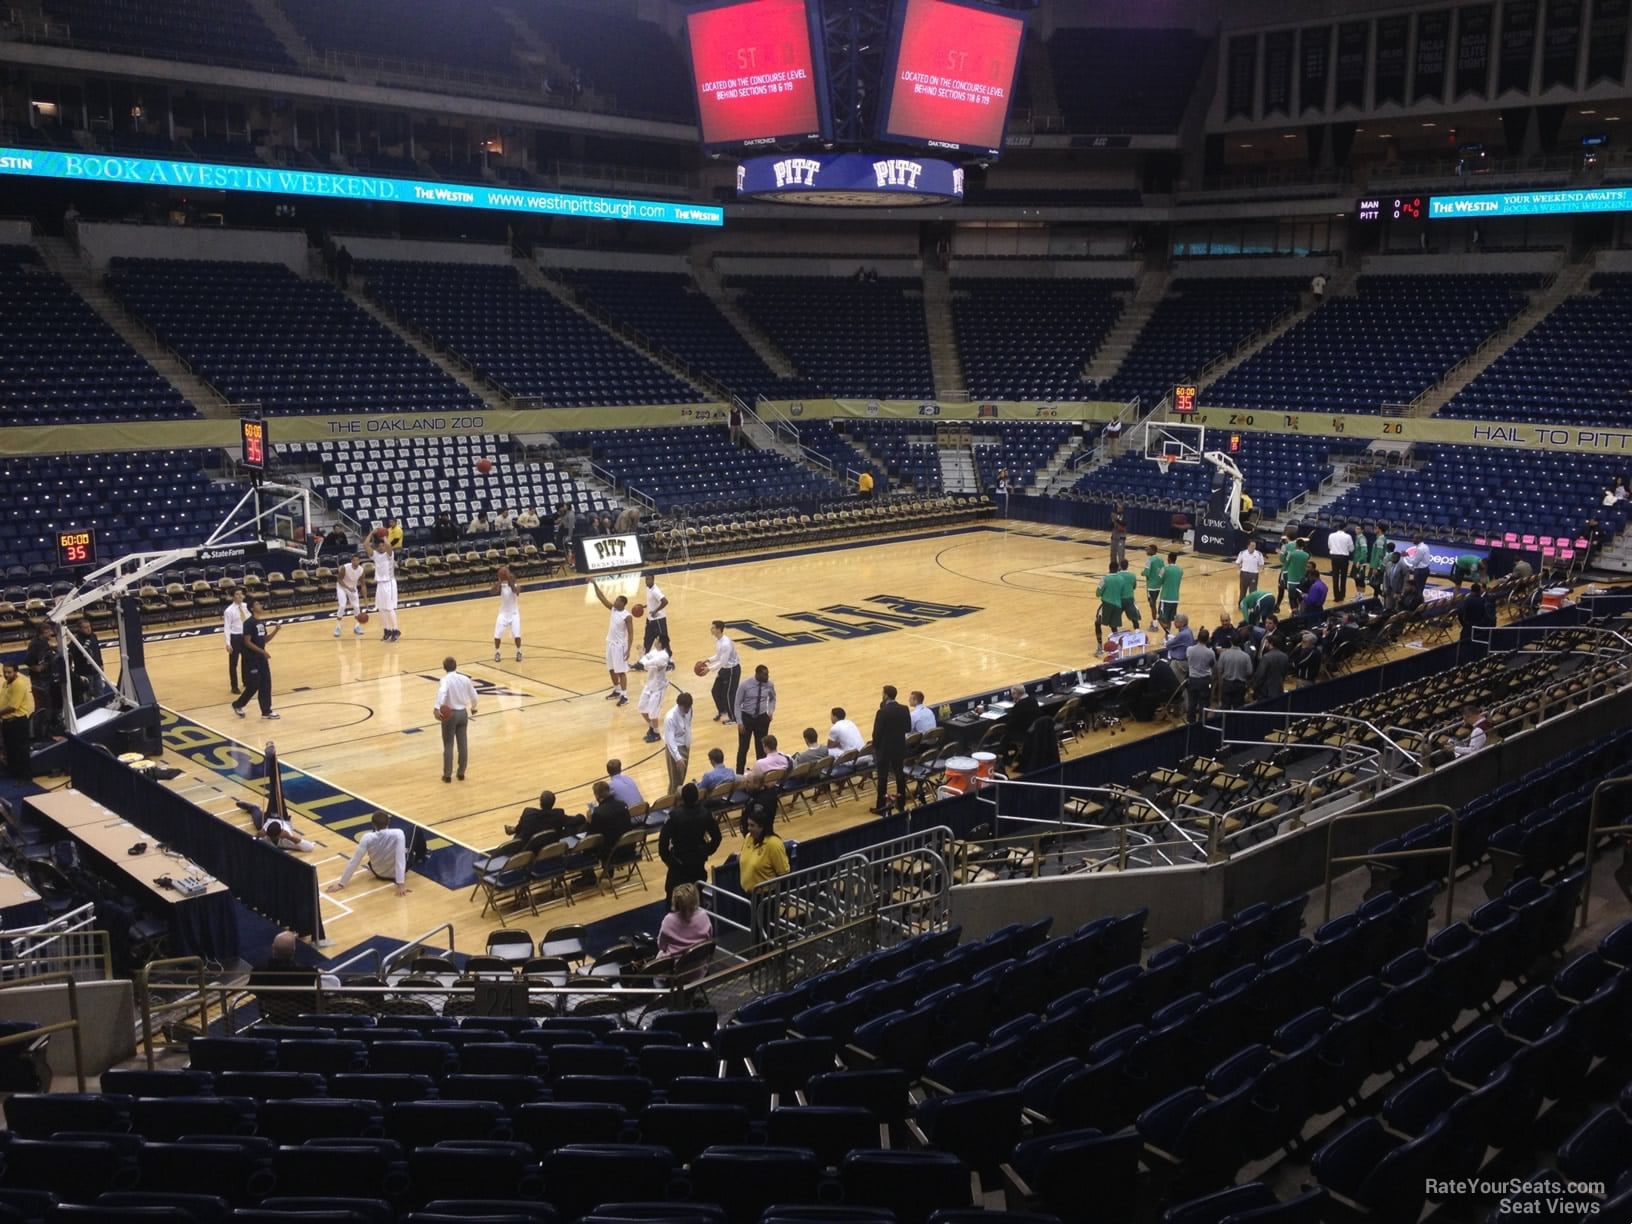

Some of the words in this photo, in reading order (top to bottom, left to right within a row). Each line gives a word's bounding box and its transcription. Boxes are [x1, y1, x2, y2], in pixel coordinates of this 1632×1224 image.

[702, 82, 728, 92] LOCATED
[728, 80, 737, 88] ON
[737, 78, 750, 87] THE
[750, 73, 787, 86] CONCOURSE
[787, 69, 807, 80] LEVEL
[901, 71, 928, 84] LOCATED
[930, 76, 939, 86] ON
[940, 78, 952, 88] THE
[952, 80, 987, 94] CONCOURSE
[987, 86, 1004, 98] LEVEL
[716, 90, 738, 101] BEHIND
[739, 85, 768, 97] SECTIONS
[914, 84, 937, 96] BEHIND
[938, 88, 966, 101] SECTIONS
[65, 155, 142, 179] BOOK
[150, 163, 168, 182] A
[172, 163, 272, 189] WESTIN
[279, 172, 399, 199] WEEKEND.
[773, 158, 821, 188] PITT
[873, 159, 922, 189] PITT
[488, 192, 665, 219] www.westinpittsburgh.com
[1361, 200, 1379, 208] MAN
[1394, 199, 1400, 207] 0
[1503, 194, 1530, 205] YOUR
[1532, 192, 1583, 203] WEEKEND
[1583, 191, 1627, 201] AWAITS!
[1360, 211, 1379, 219] PITT
[1393, 210, 1400, 218] 0
[1504, 203, 1531, 213] BOOK
[1176, 387, 1195, 396] 60:00
[1178, 396, 1191, 409] 35
[328, 421, 360, 433] THE
[367, 418, 446, 432] OAKLAND
[451, 416, 484, 429] ZOO
[1474, 426, 1525, 442] HAIL
[1535, 429, 1569, 445] TO
[1577, 432, 1632, 449] PITT
[1203, 519, 1226, 528] UPMC
[61, 534, 89, 546] 60:00
[1209, 536, 1225, 545] PNC
[68, 546, 86, 560] 35
[594, 539, 626, 559] PITT
[722, 594, 986, 650] PITT
